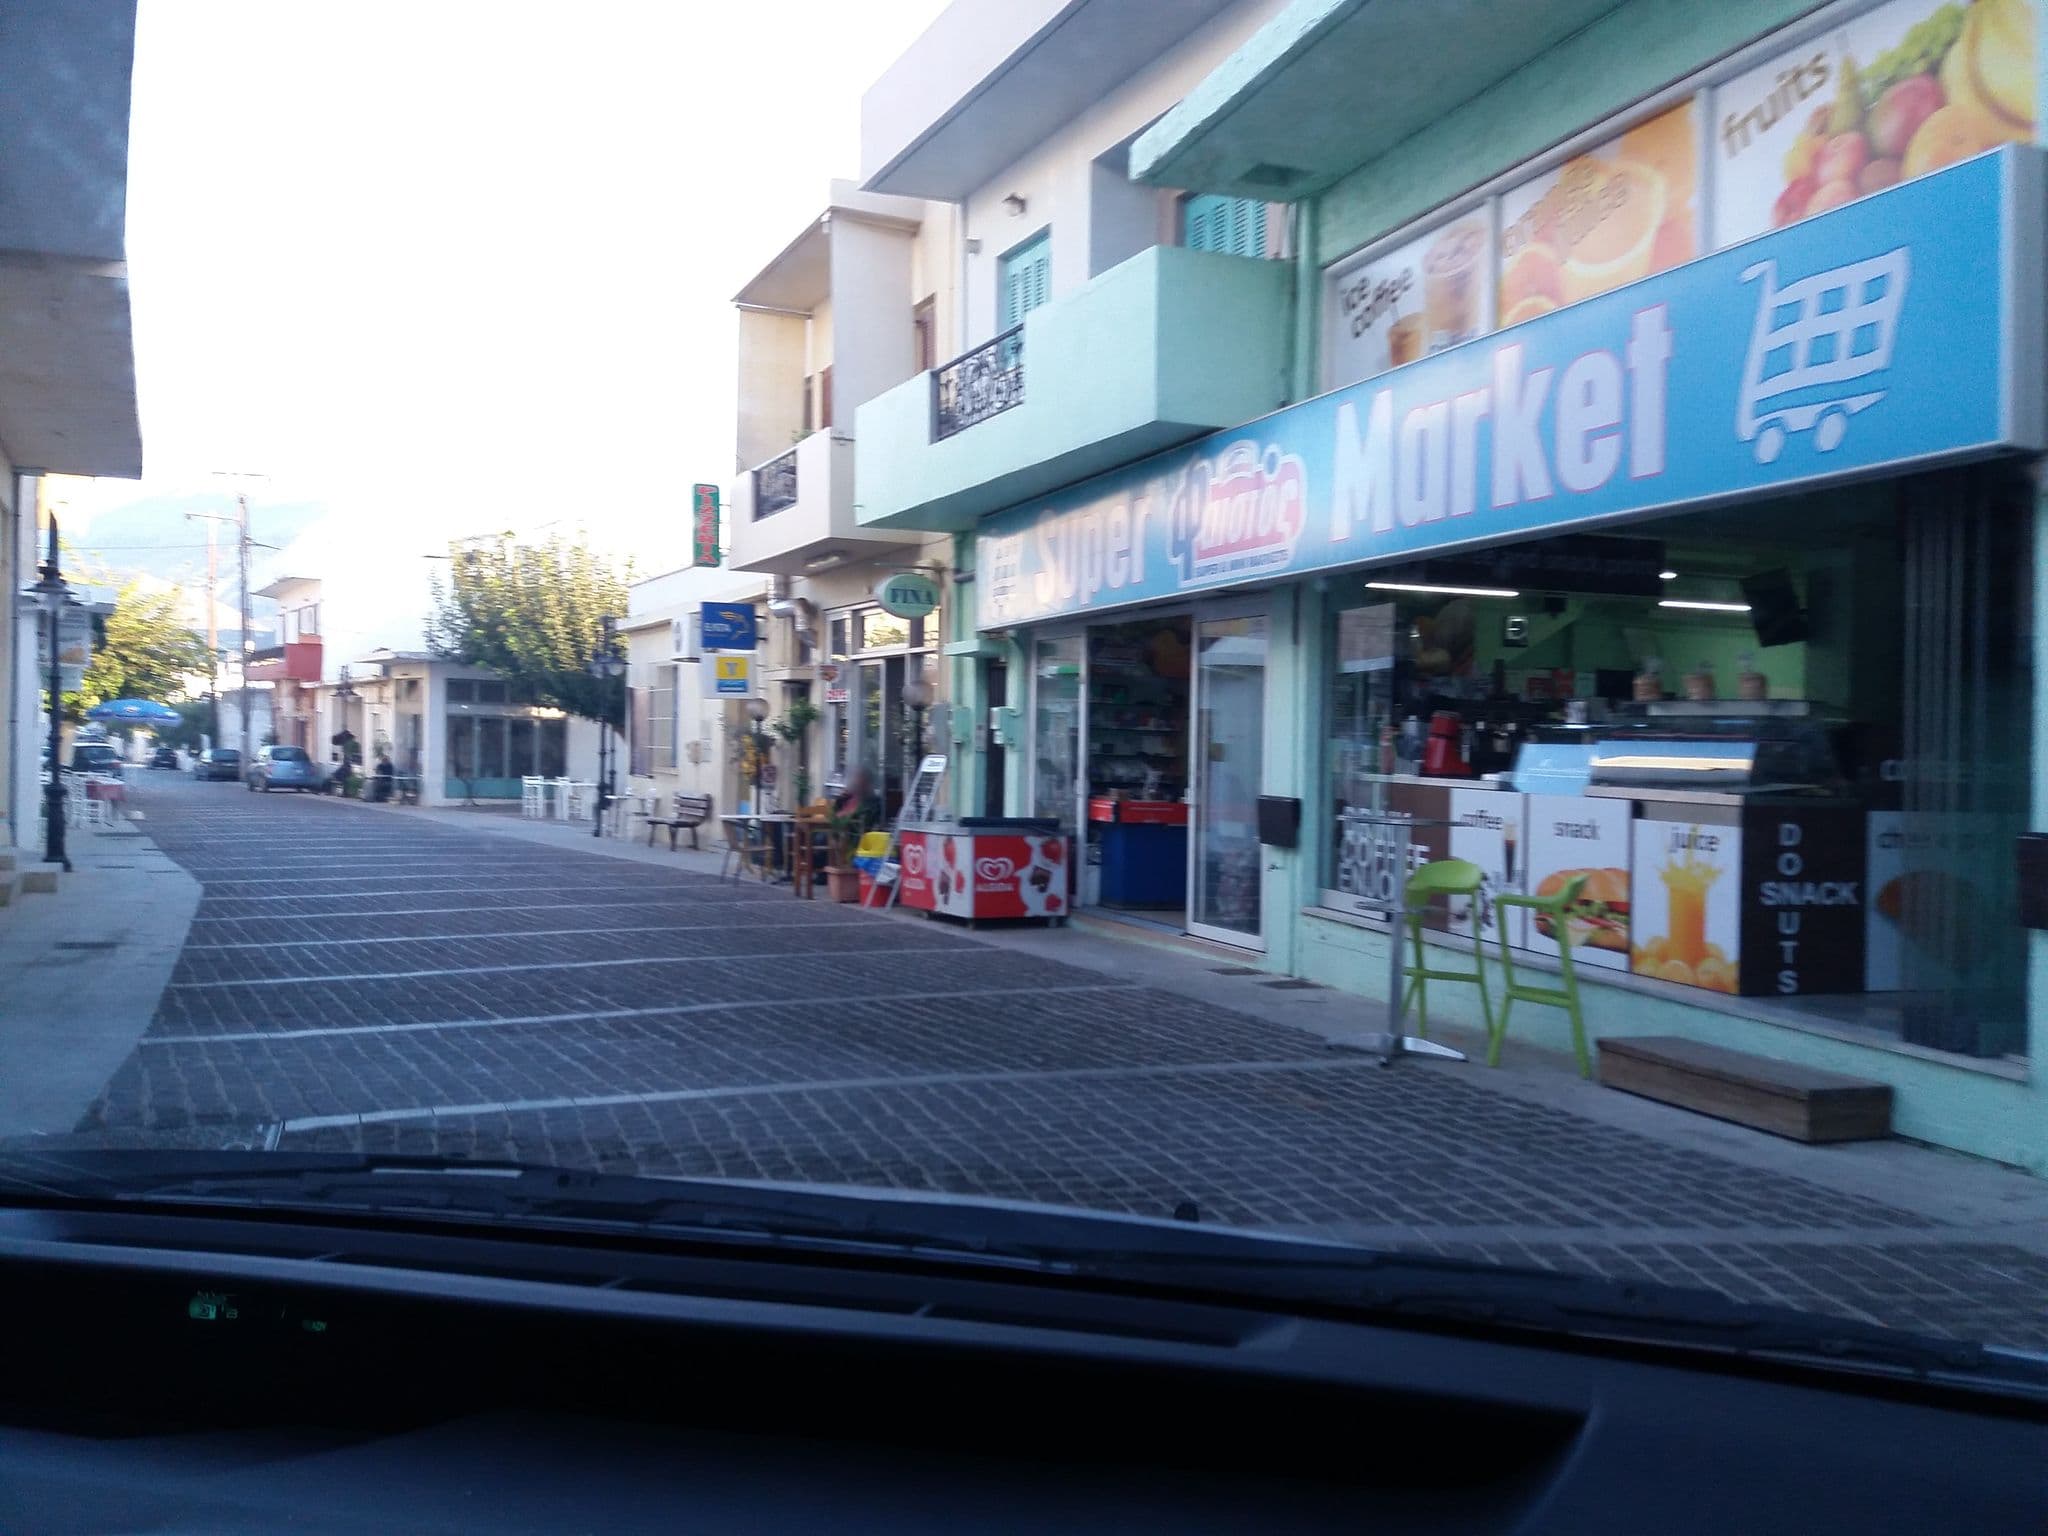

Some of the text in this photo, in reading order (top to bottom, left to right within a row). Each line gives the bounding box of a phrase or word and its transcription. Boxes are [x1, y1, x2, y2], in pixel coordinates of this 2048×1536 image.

[1720, 50, 1834, 160] fruits
[1340, 276, 1369, 316] ice
[1352, 267, 1414, 339] coffee
[1034, 496, 1152, 607] Super
[1329, 304, 1674, 543] Market
[1462, 810, 1504, 831] coffee
[1553, 818, 1600, 840] snack
[1669, 826, 1720, 853] juice
[1760, 881, 1858, 906] SNACK
